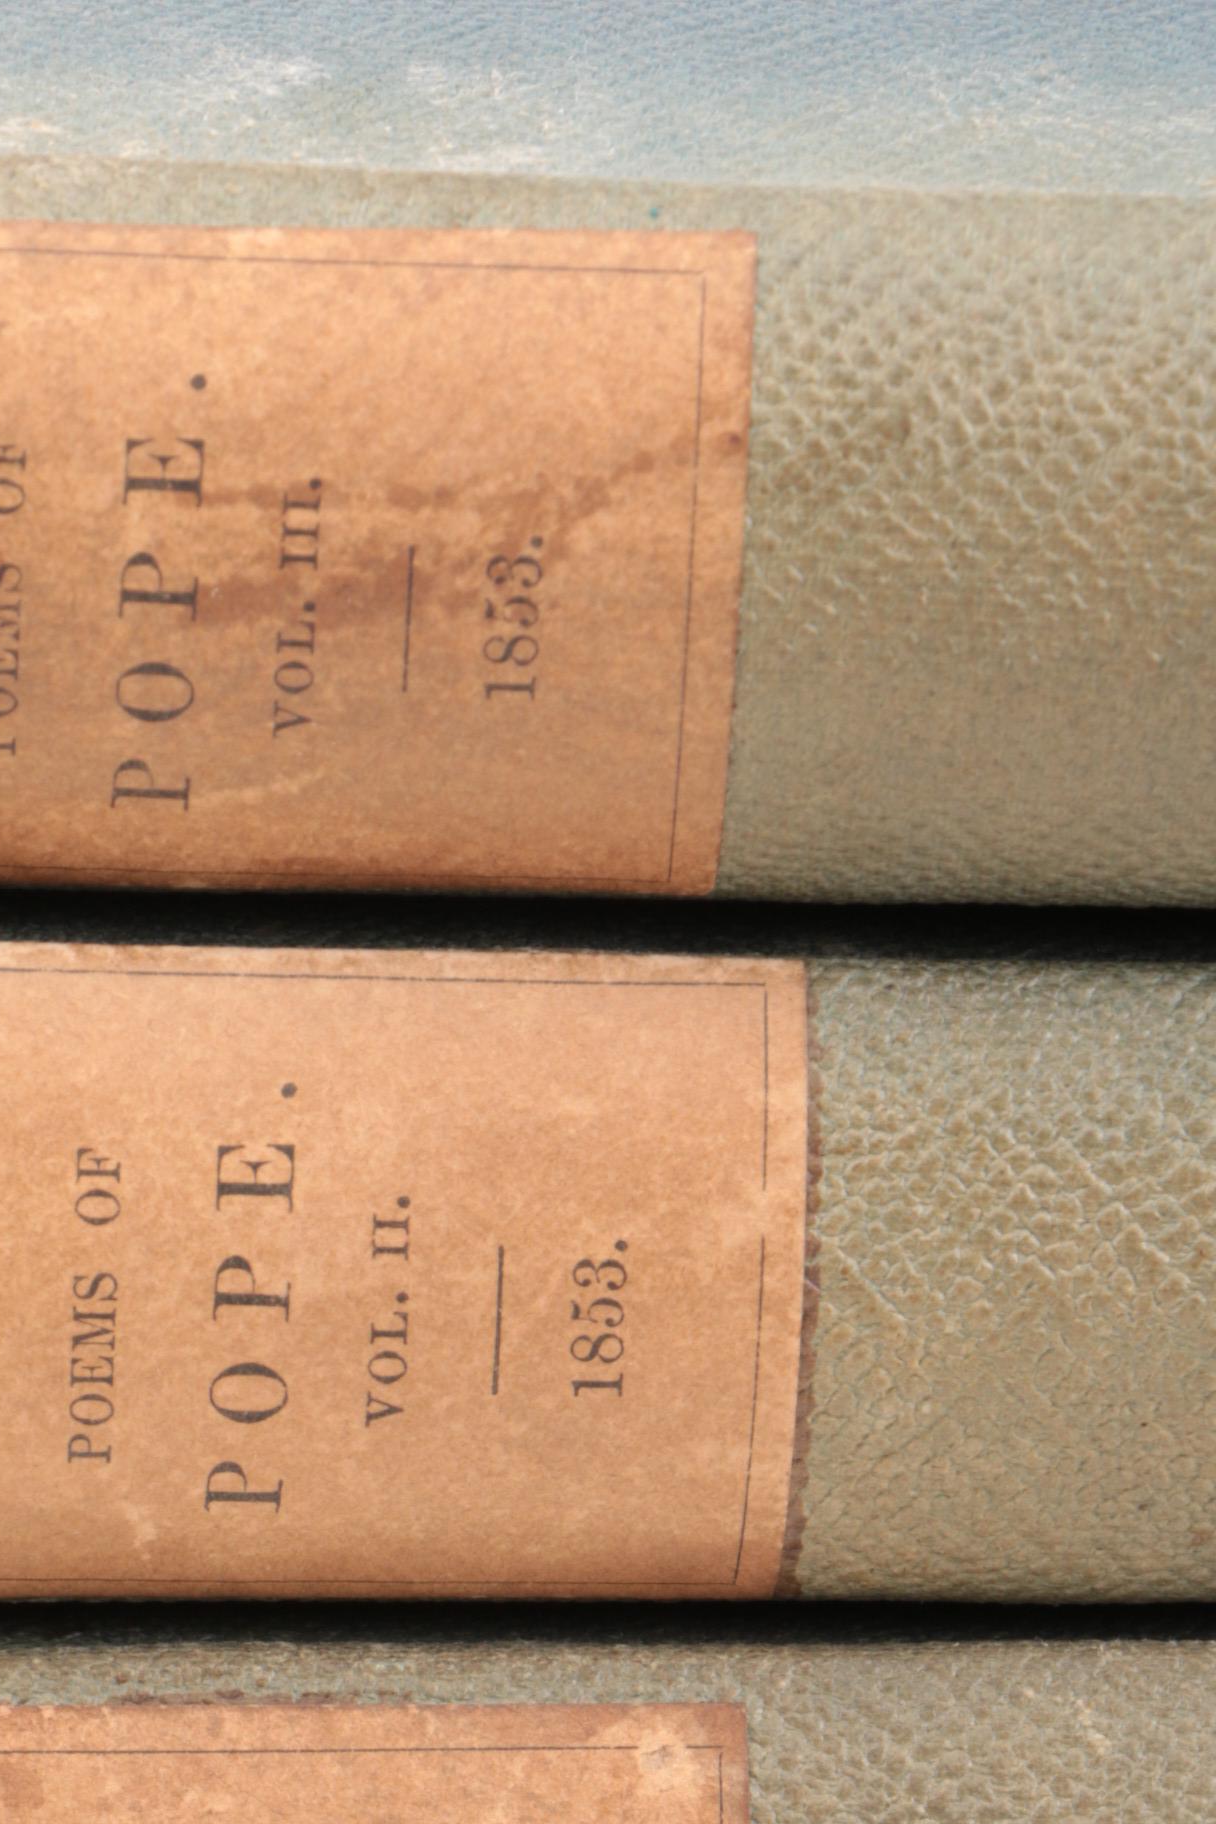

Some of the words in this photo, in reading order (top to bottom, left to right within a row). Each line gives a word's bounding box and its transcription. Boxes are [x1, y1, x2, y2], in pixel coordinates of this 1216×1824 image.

[111, 372, 208, 812] POPE.
[280, 477, 324, 569] III.
[272, 601, 319, 737] VOL.
[483, 536, 544, 703] 1853.
[75, 1146, 123, 1226] OF
[370, 1194, 411, 1261] II.
[67, 1272, 120, 1464] POEMS
[204, 1080, 298, 1515] POPE.
[365, 1292, 409, 1427] VOL.
[571, 1239, 629, 1400] 1853.
